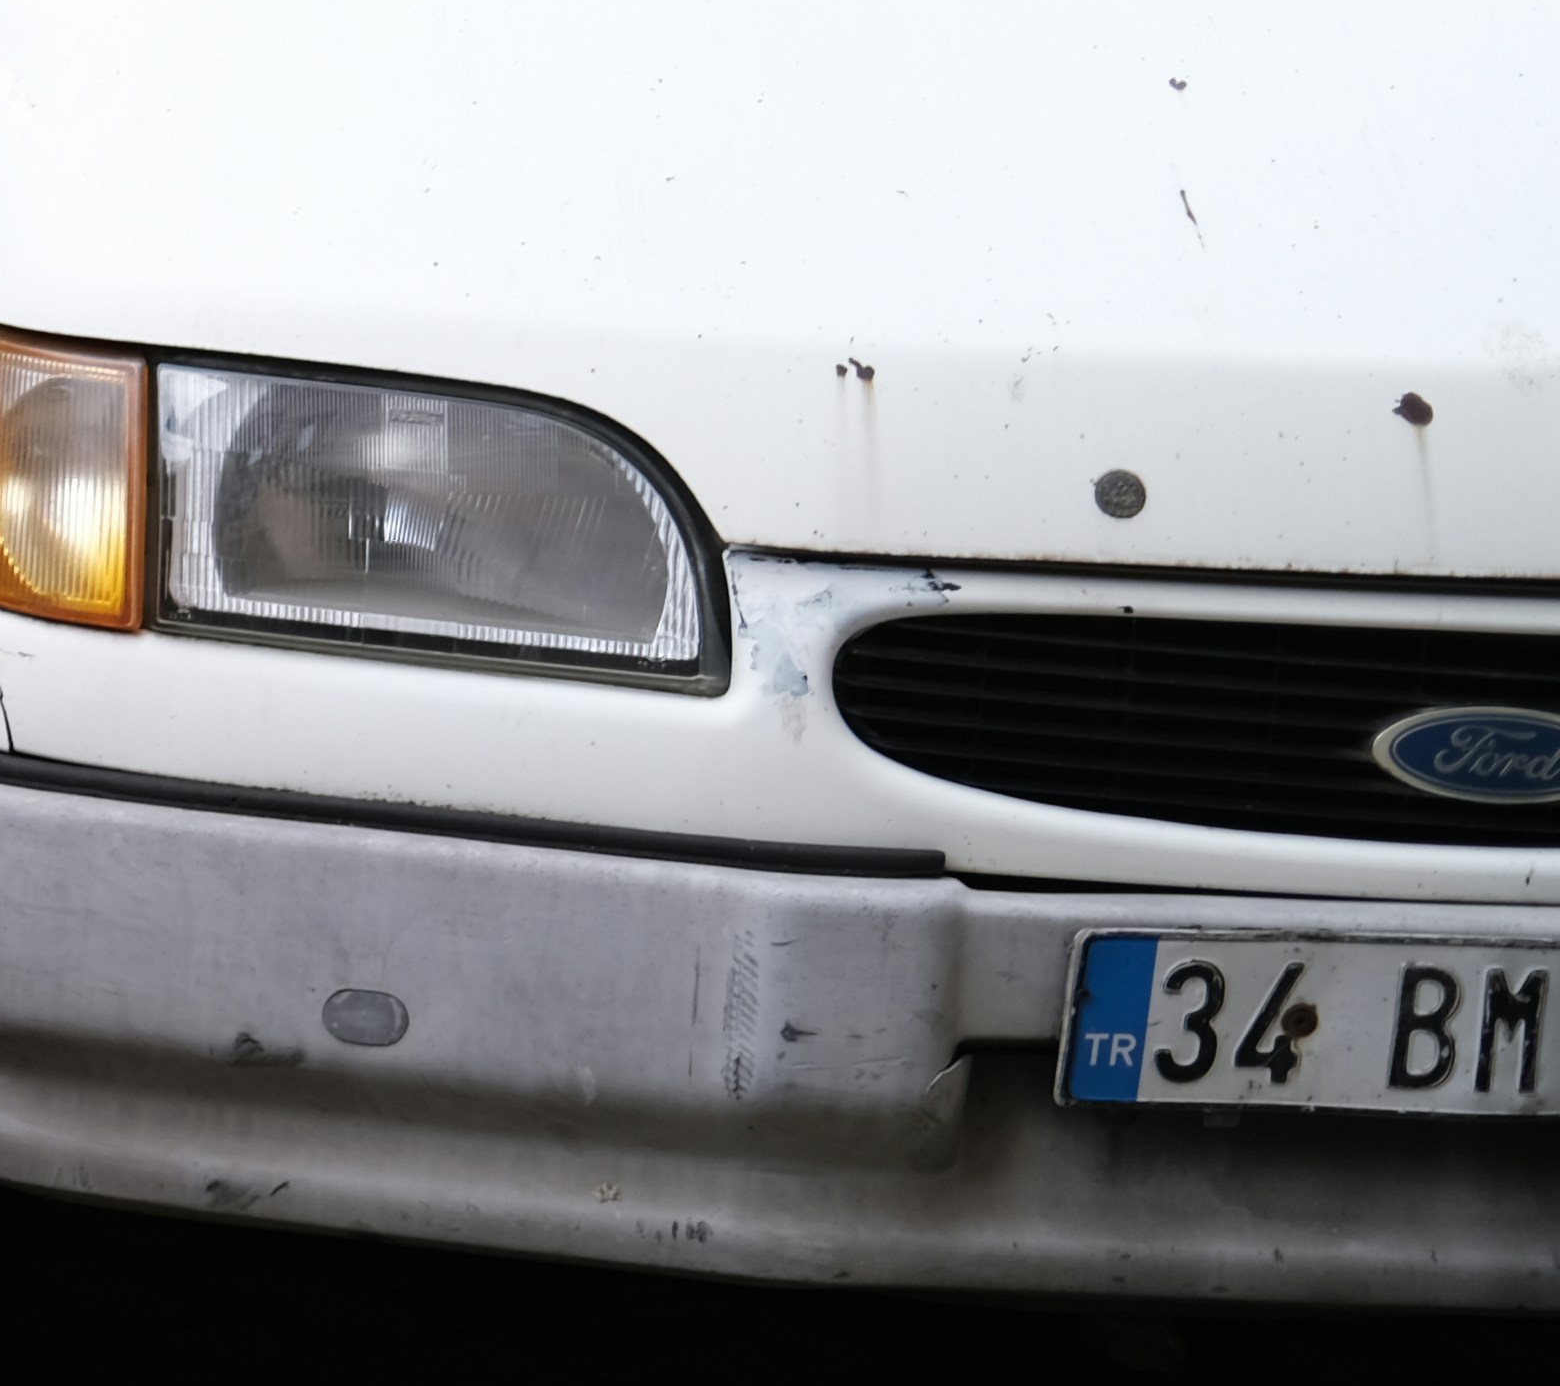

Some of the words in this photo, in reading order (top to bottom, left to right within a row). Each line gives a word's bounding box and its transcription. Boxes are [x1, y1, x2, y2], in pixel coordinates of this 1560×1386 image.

[1433, 724, 1560, 781] Ford
[1084, 1032, 1137, 1066] TR
[1153, 959, 1306, 1085] 34
[1385, 962, 1550, 1094] BM
